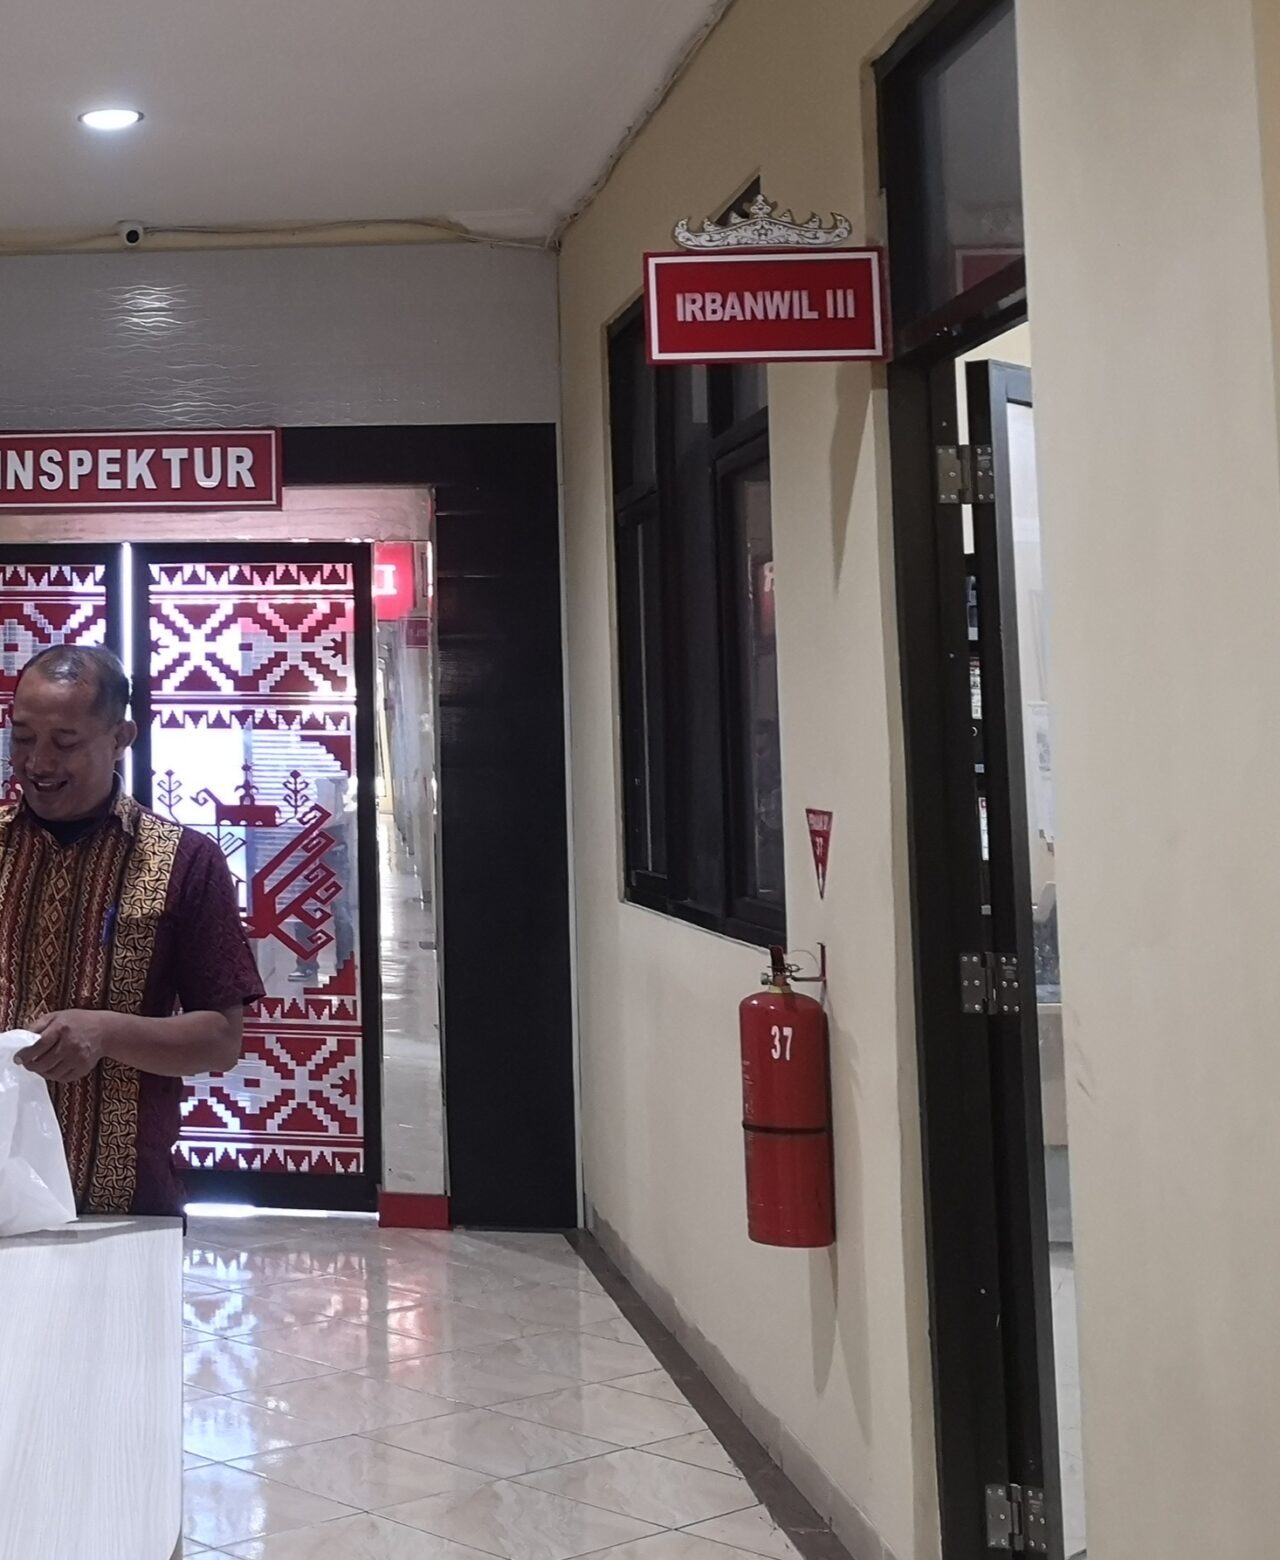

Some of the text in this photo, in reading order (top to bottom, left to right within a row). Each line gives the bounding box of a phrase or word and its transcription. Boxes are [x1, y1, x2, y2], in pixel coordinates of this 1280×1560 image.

[676, 289, 855, 322] IRBANWIL III
[770, 1025, 793, 1061] 37
